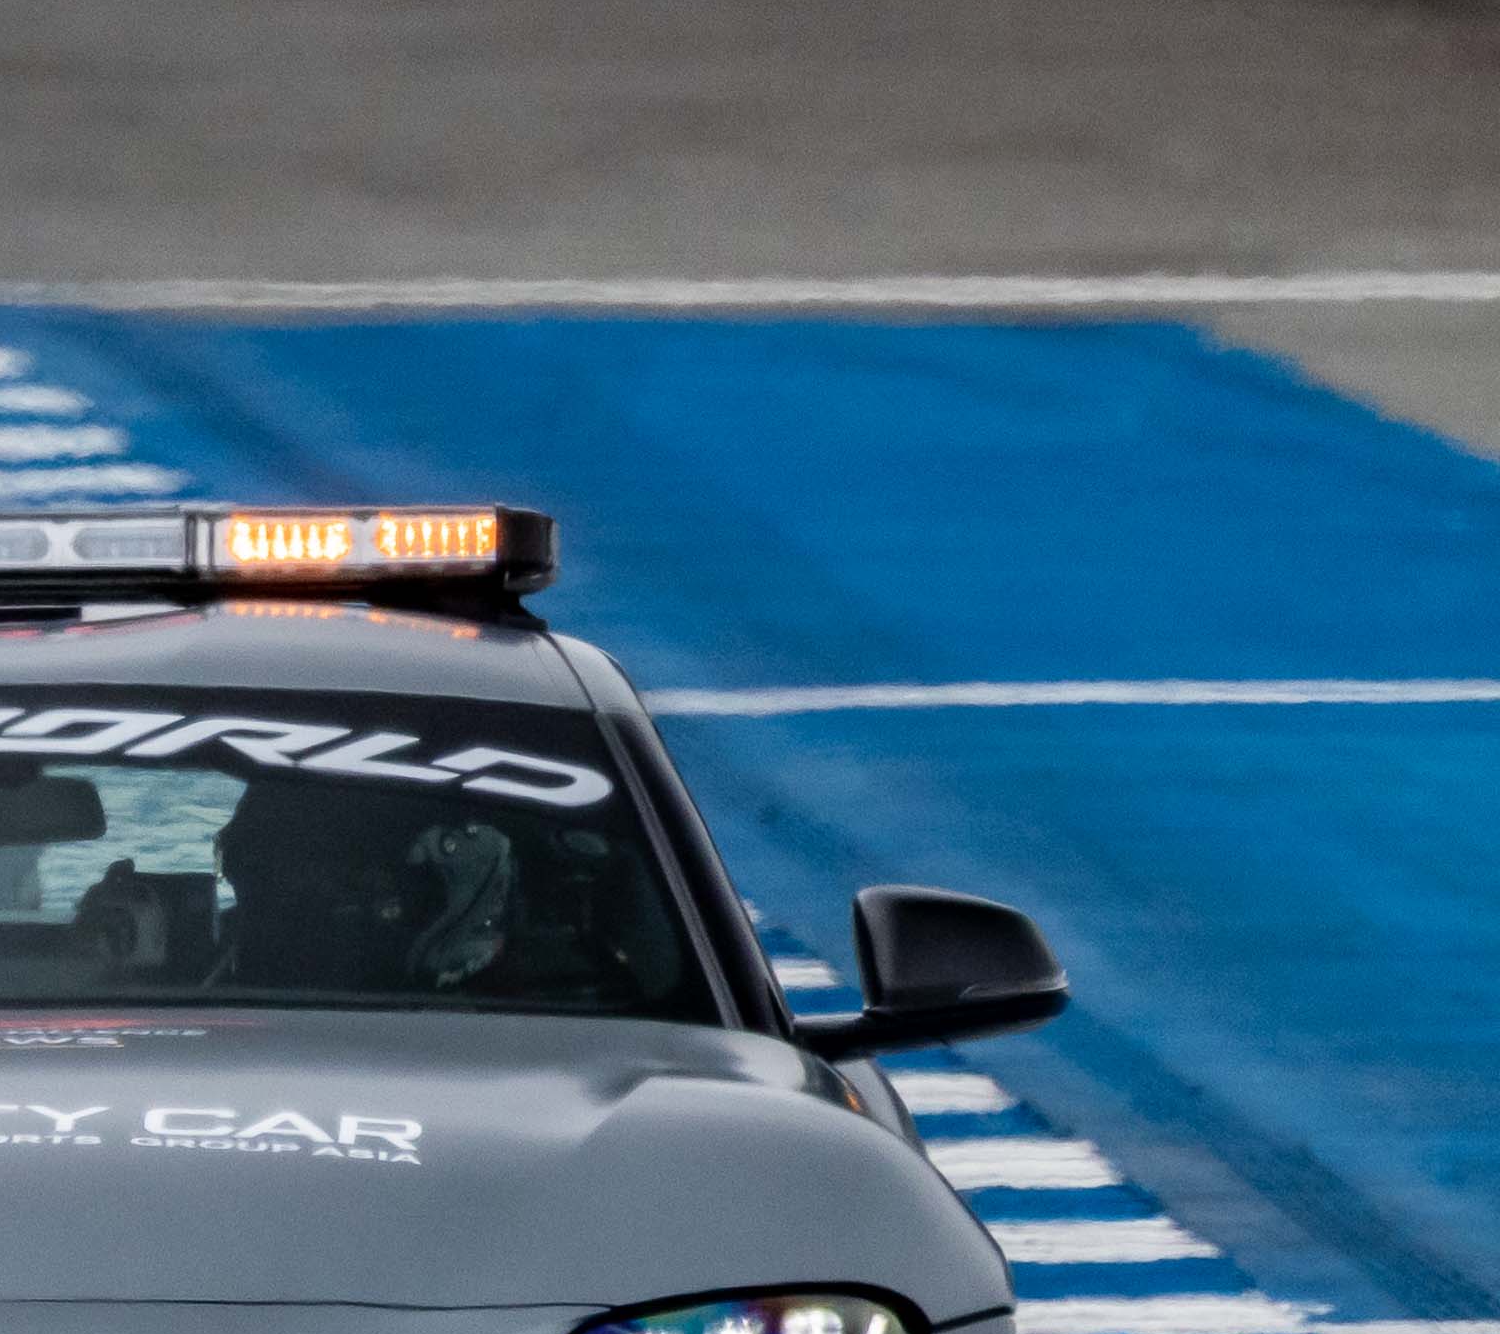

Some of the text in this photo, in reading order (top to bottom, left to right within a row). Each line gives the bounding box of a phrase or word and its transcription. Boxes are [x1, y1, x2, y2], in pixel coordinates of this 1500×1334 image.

[143, 1107, 423, 1151] CAR
[130, 1136, 302, 1152] GROUP
[311, 1146, 422, 1166] ASIA
